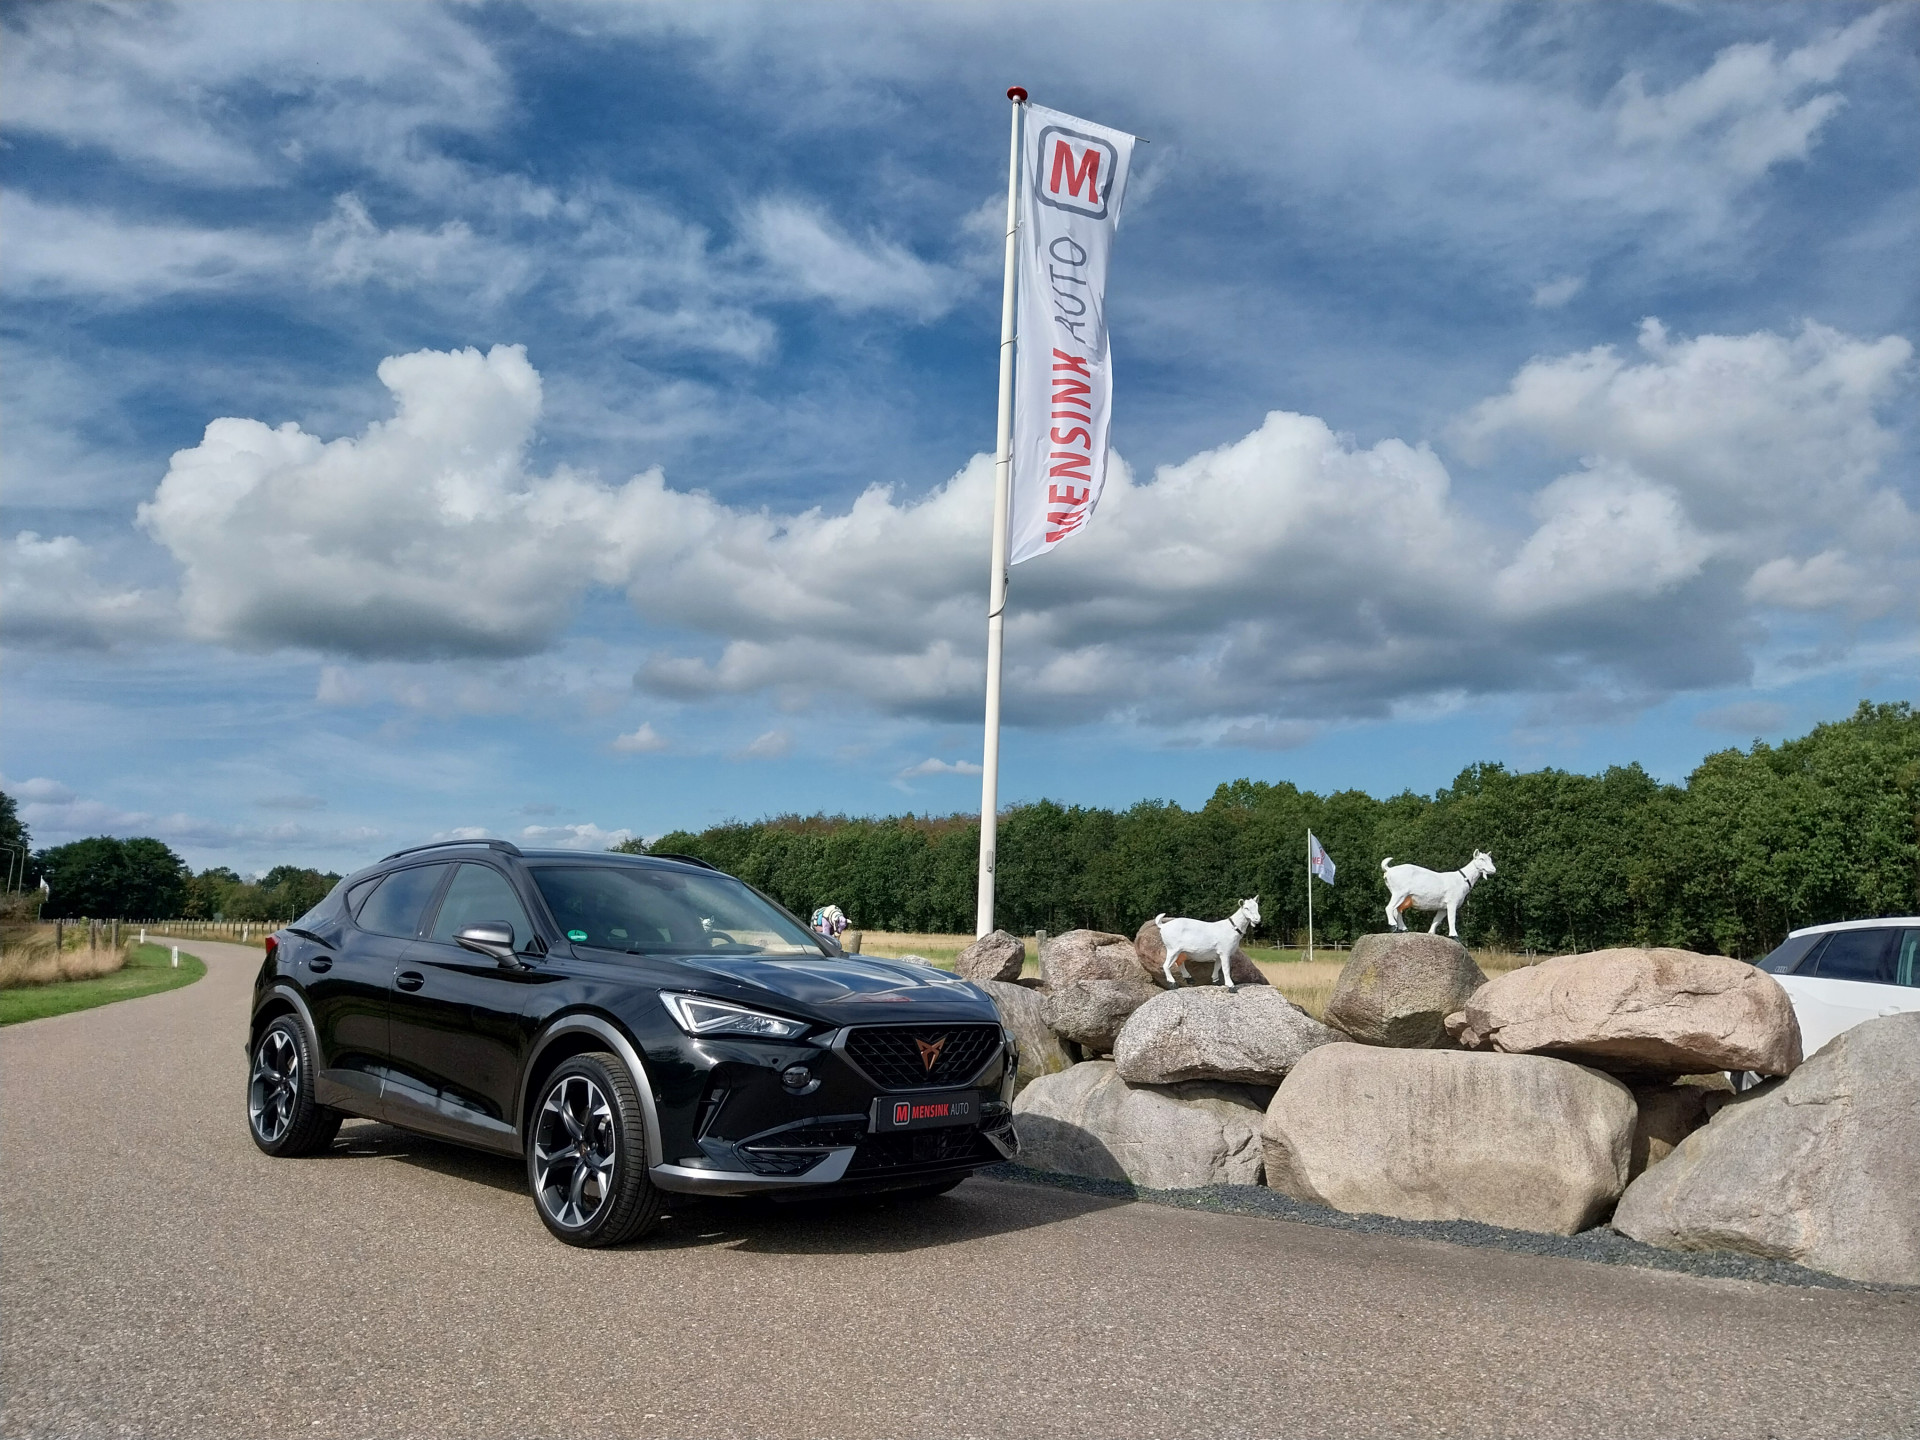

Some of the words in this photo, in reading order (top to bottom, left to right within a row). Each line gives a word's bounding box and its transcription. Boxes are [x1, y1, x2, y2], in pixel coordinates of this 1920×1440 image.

[1050, 139, 1101, 204] M
[1049, 236, 1087, 344] AUTO
[1045, 347, 1092, 543] MENSINK
[896, 1105, 908, 1122] M
[911, 1103, 949, 1119] MENSINK
[950, 1102, 969, 1116] AUTO
